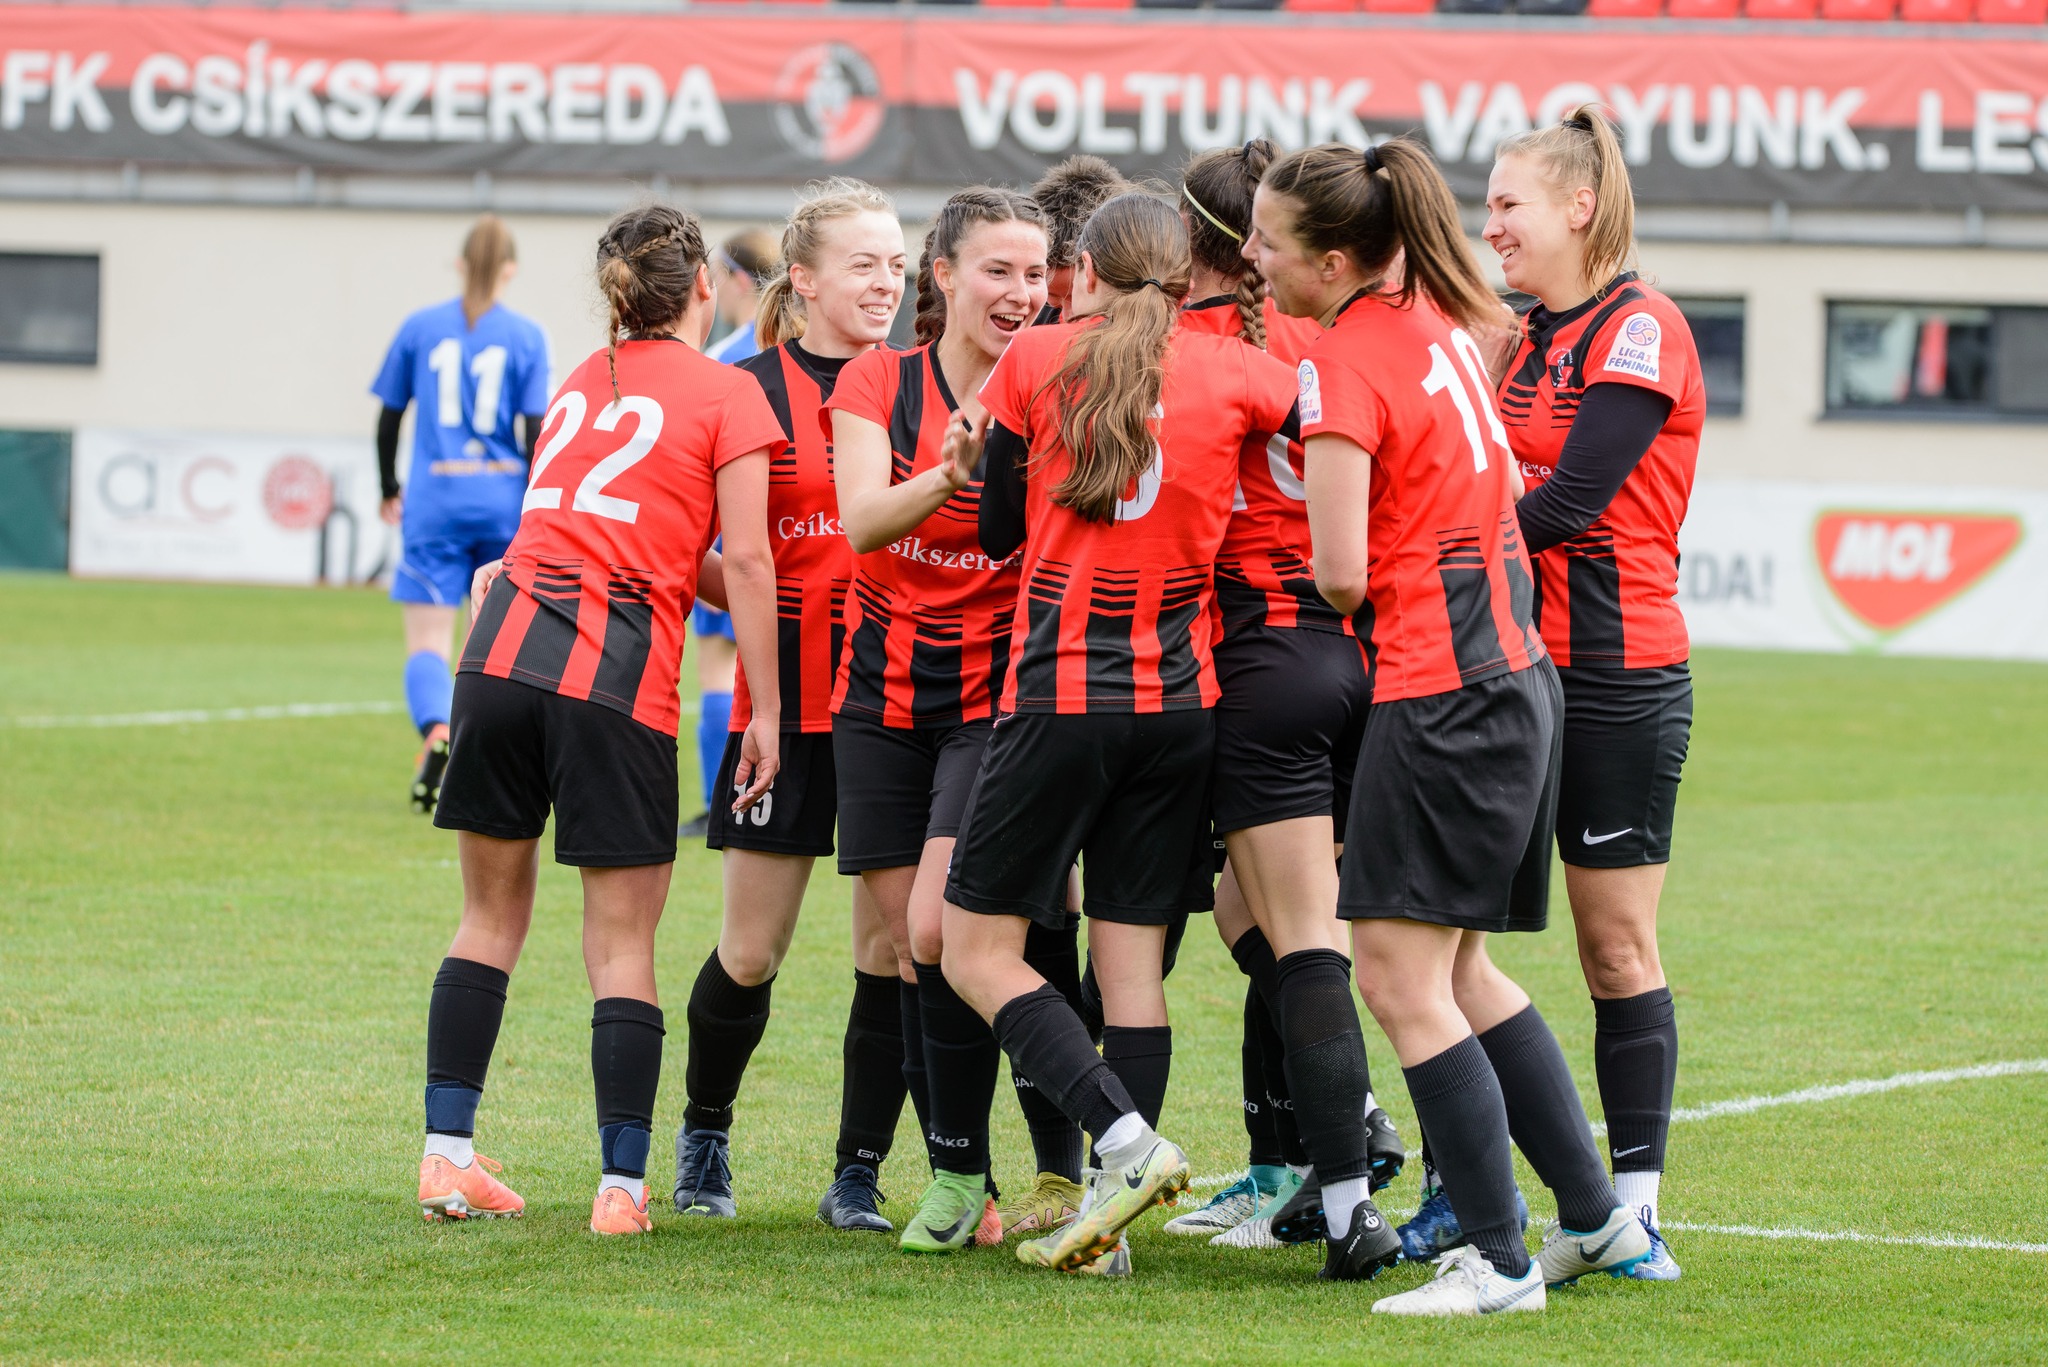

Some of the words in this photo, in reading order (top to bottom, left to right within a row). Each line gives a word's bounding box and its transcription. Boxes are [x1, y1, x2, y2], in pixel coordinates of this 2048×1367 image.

[2, 50, 113, 132] FK
[129, 38, 730, 147] CSÍKSZEREDA
[428, 337, 508, 435] 11
[1597, 357, 1658, 377] FEMININ
[521, 390, 665, 525] 22
[777, 511, 846, 540] Csíks
[1830, 520, 1955, 581] MOL
